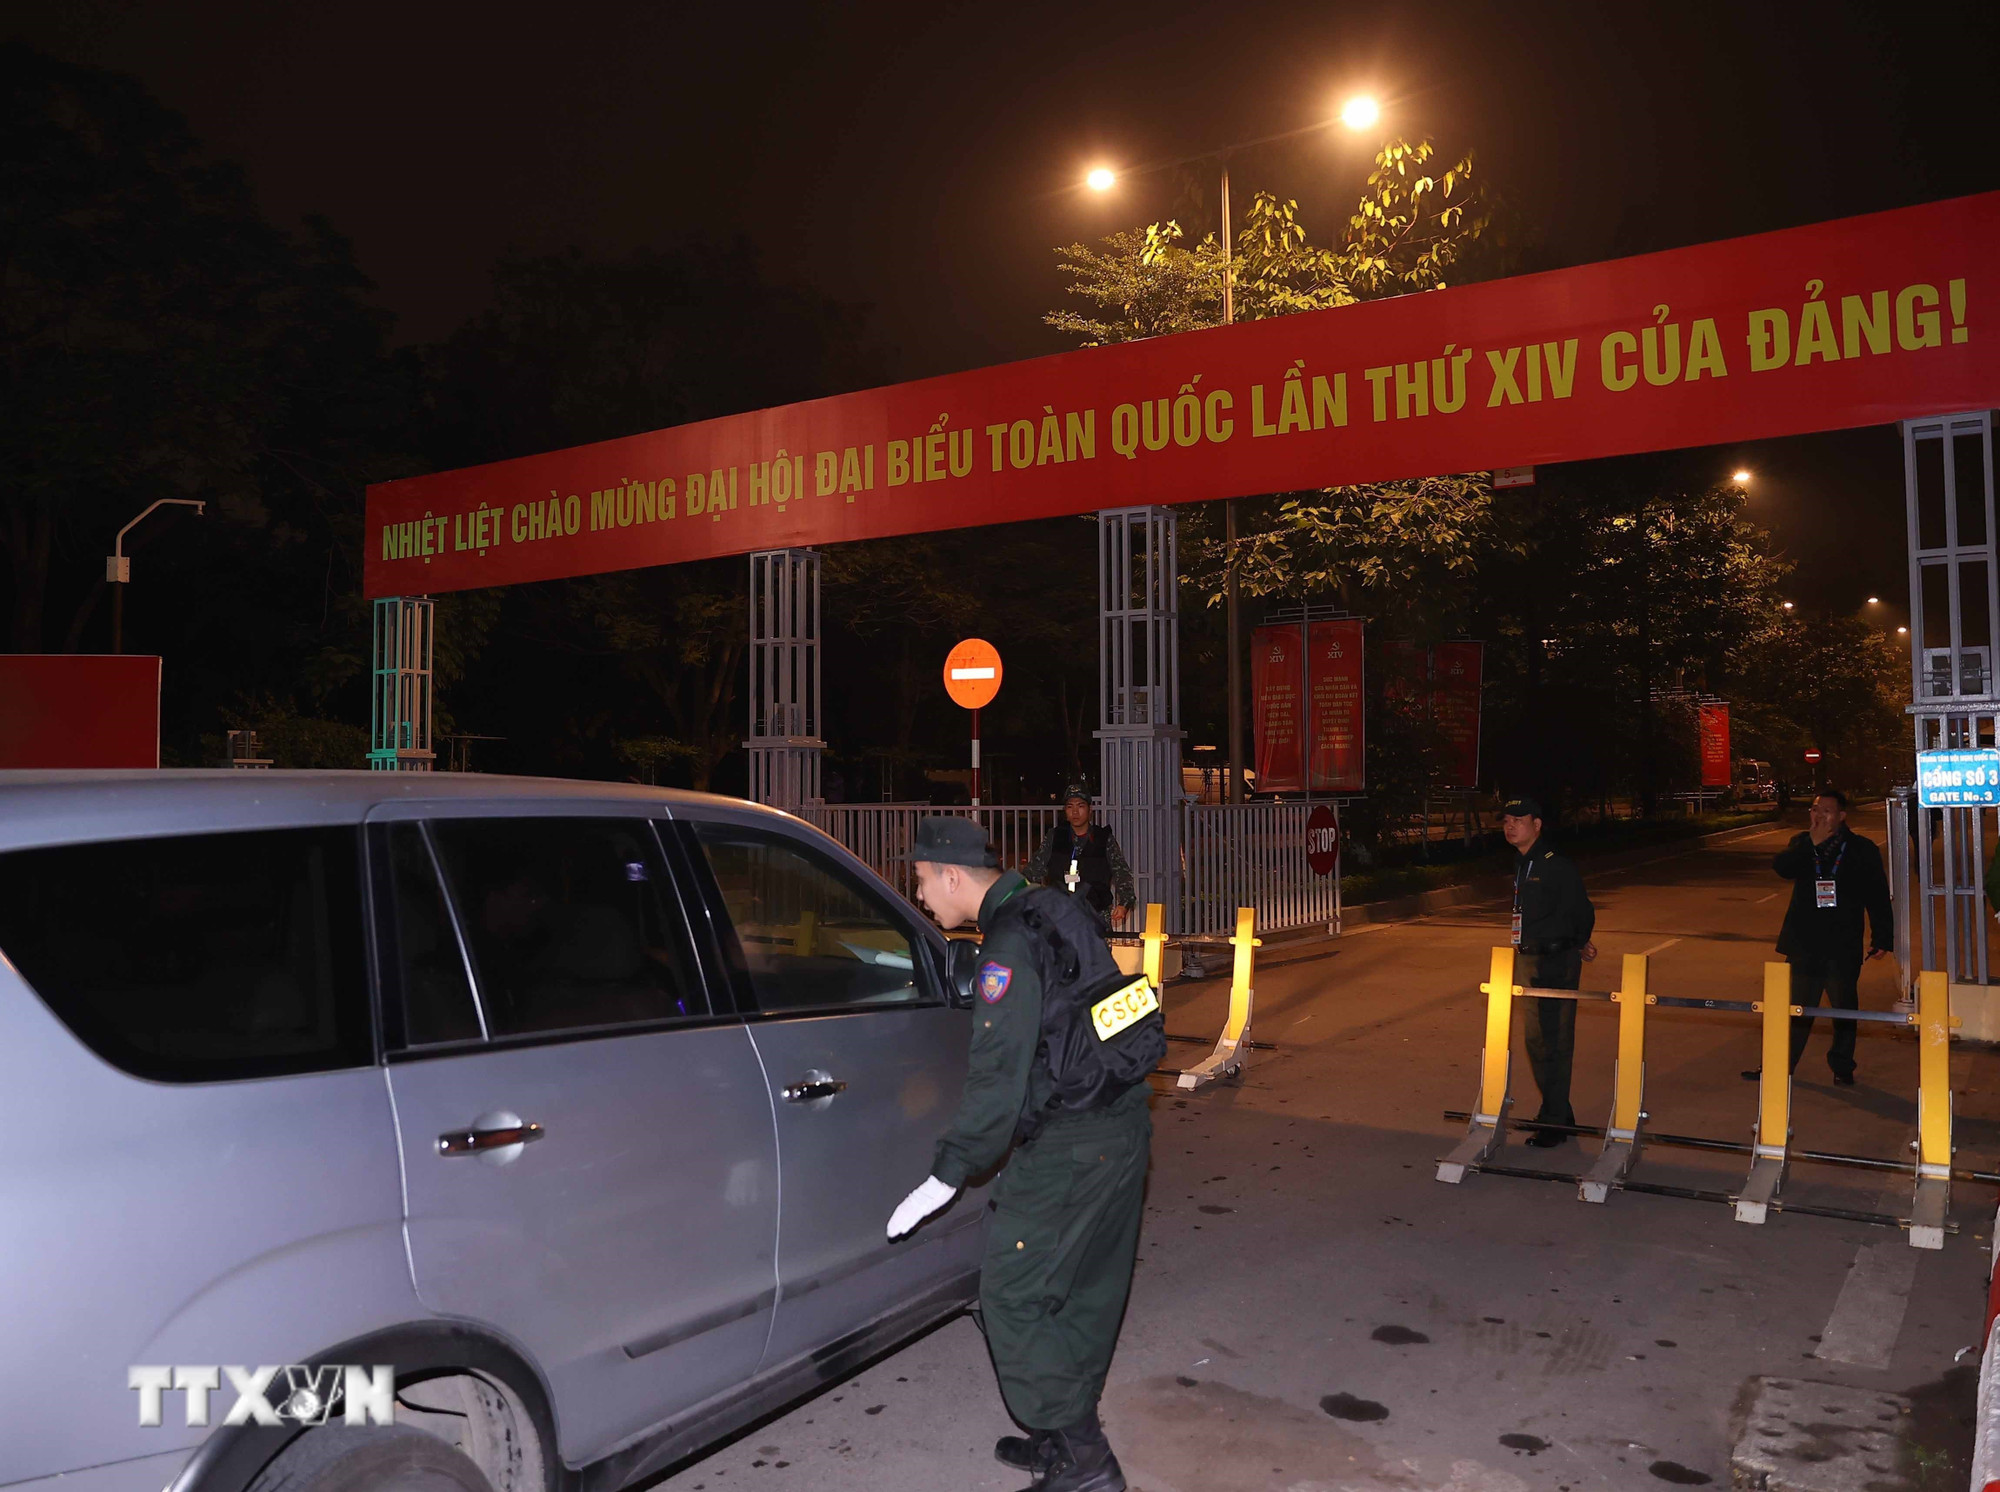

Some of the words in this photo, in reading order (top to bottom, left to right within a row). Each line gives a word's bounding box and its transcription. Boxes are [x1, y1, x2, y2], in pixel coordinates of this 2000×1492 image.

[383, 511, 448, 563] NHIỆT
[456, 502, 504, 556] LIỆT
[512, 490, 580, 542] CHÀO
[591, 476, 675, 531] MỪNG
[686, 467, 738, 522] ĐẠI
[750, 449, 803, 512] HỘI
[815, 444, 873, 503] ĐẠI
[888, 413, 973, 486] BIỂU
[986, 406, 1096, 472] TOÀN
[1111, 374, 1234, 459] QUỐC
[1252, 359, 1348, 437] LẦN
[1365, 344, 1473, 421] THỨ
[1486, 338, 1579, 407] XIV
[1601, 304, 1728, 391] CỦA
[1746, 278, 1969, 372] ĐẢNG!
[1270, 655, 1286, 663] XIV
[1327, 651, 1344, 659] XIV
[1965, 764, 1985, 786] SỐ
[1989, 769, 1998, 786] 3
[1929, 791, 1960, 802] GATE
[1307, 827, 1336, 854] STOP
